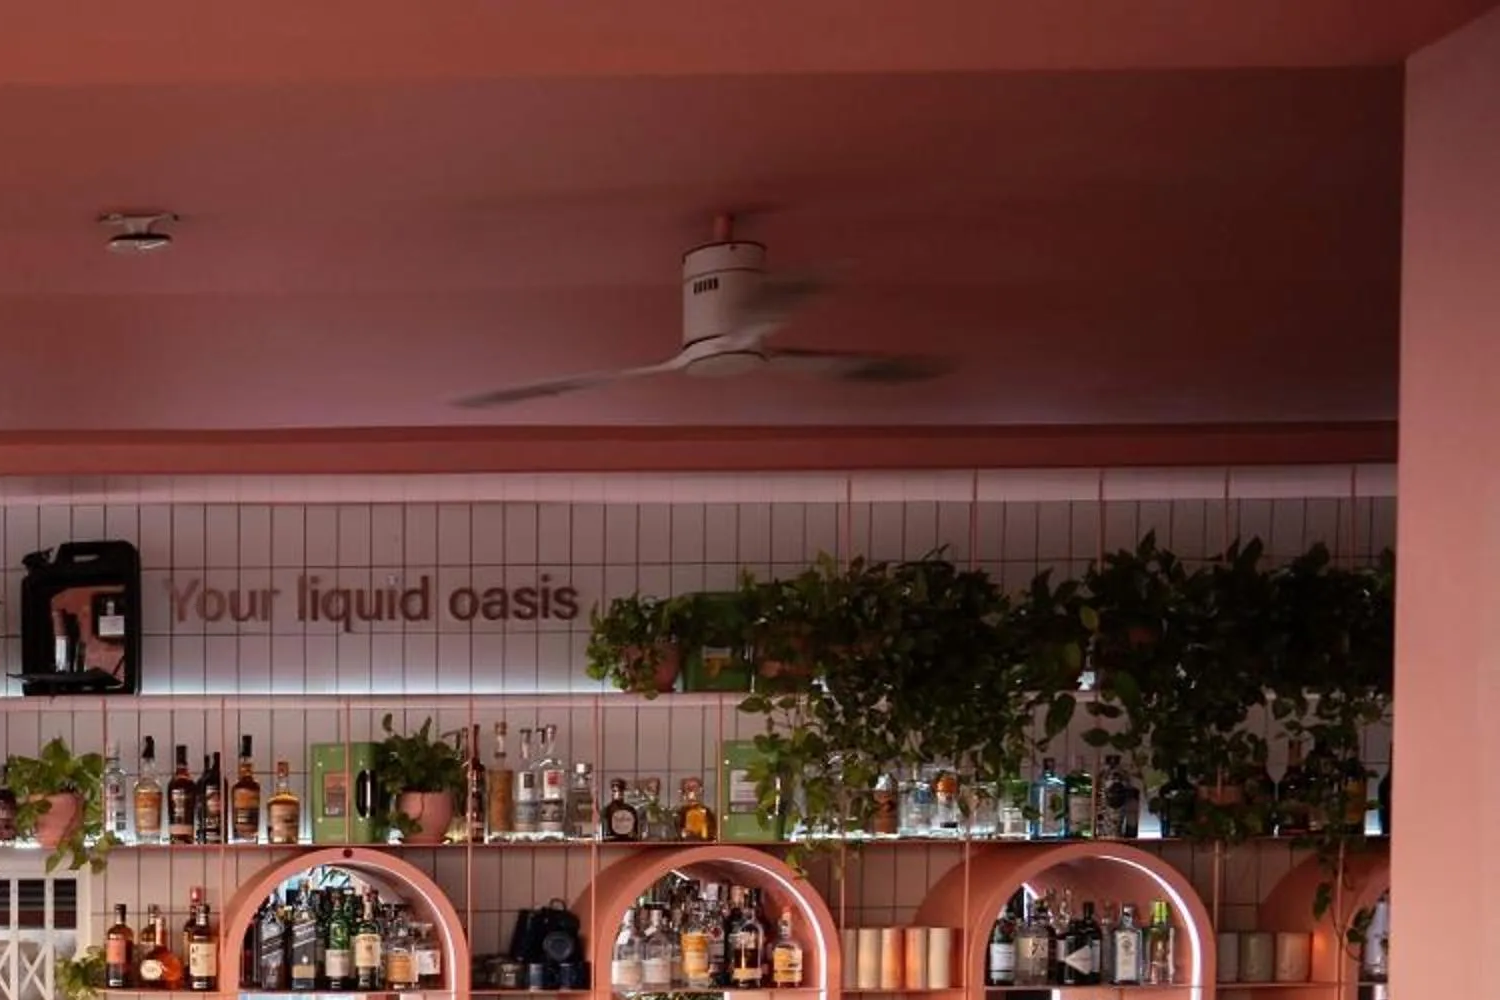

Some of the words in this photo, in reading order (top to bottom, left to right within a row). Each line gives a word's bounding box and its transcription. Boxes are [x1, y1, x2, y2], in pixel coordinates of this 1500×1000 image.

[163, 577, 281, 623] Your
[297, 574, 430, 634] liquid
[448, 573, 580, 621] oasis
